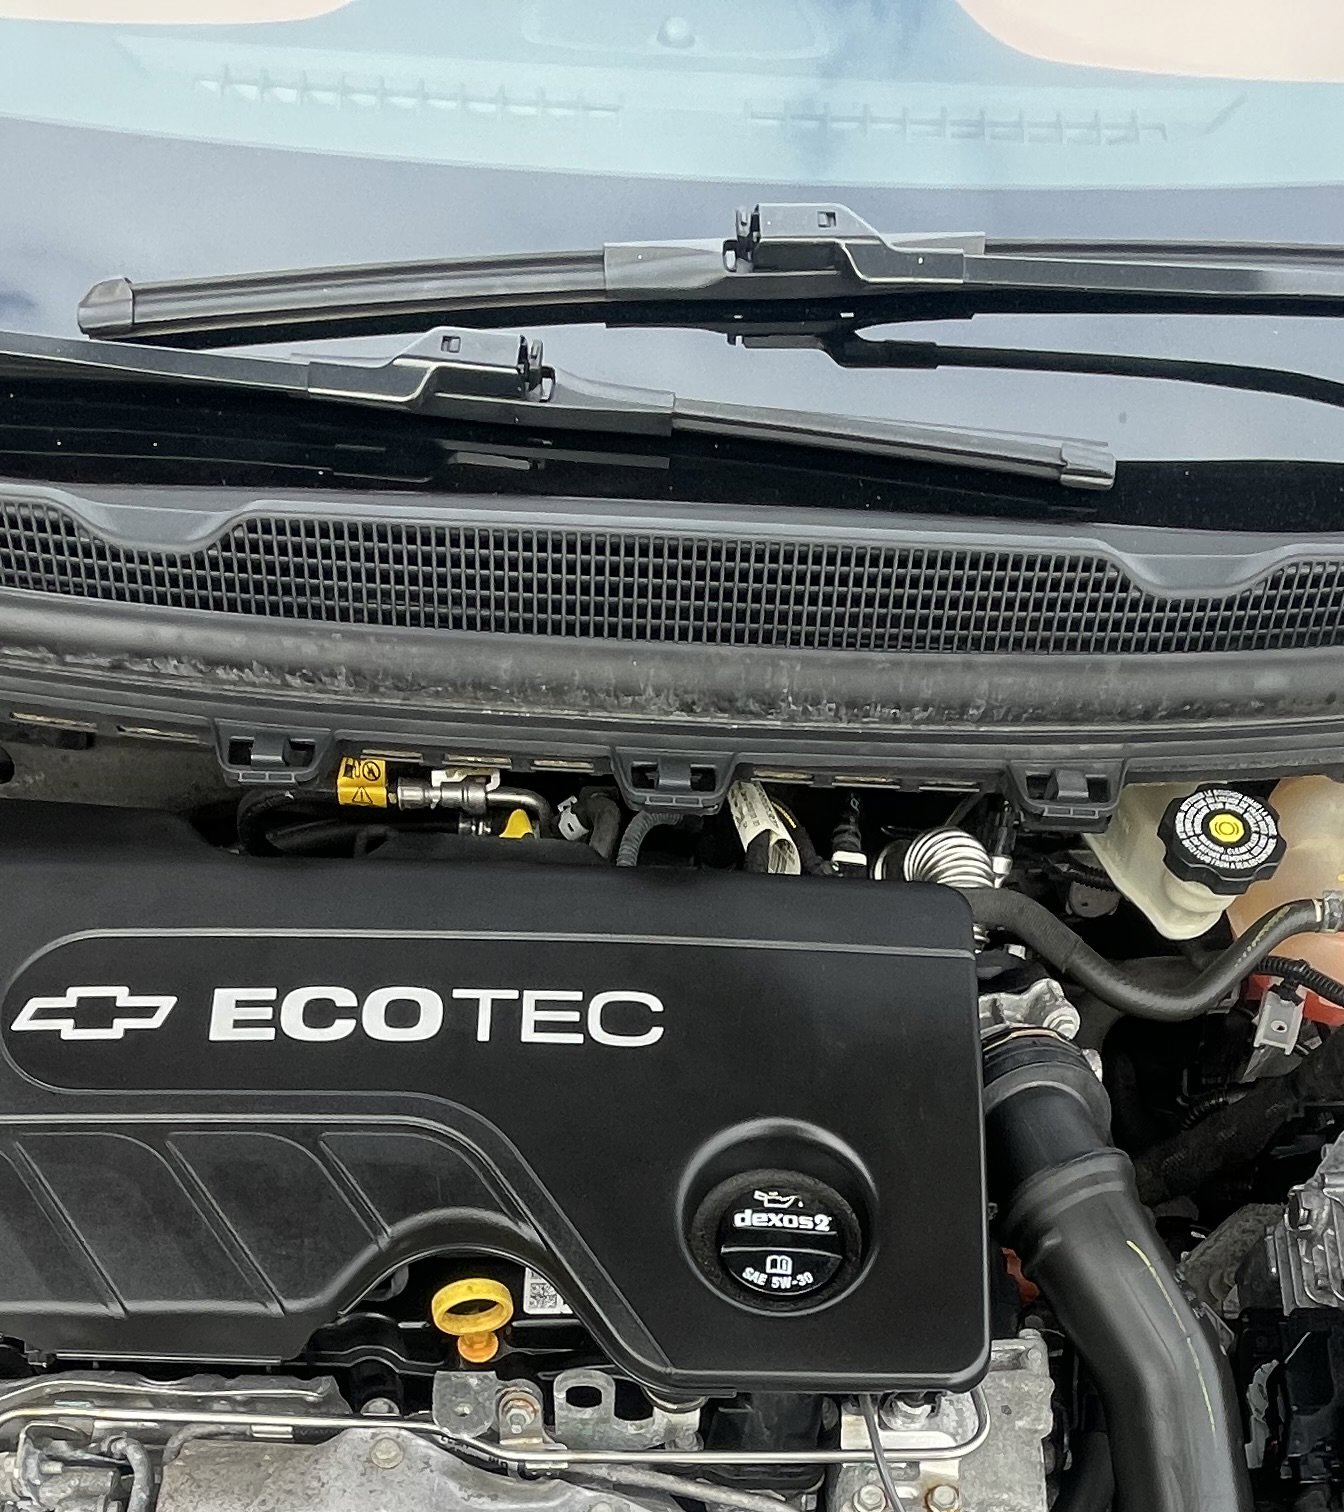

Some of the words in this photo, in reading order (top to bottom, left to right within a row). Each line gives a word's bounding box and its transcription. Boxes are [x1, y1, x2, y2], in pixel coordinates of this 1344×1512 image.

[208, 985, 665, 1048] ECOTEC
[734, 1209, 830, 1231] dexos2
[742, 1267, 768, 1287] SAE
[771, 1272, 814, 1289] 5W-30
